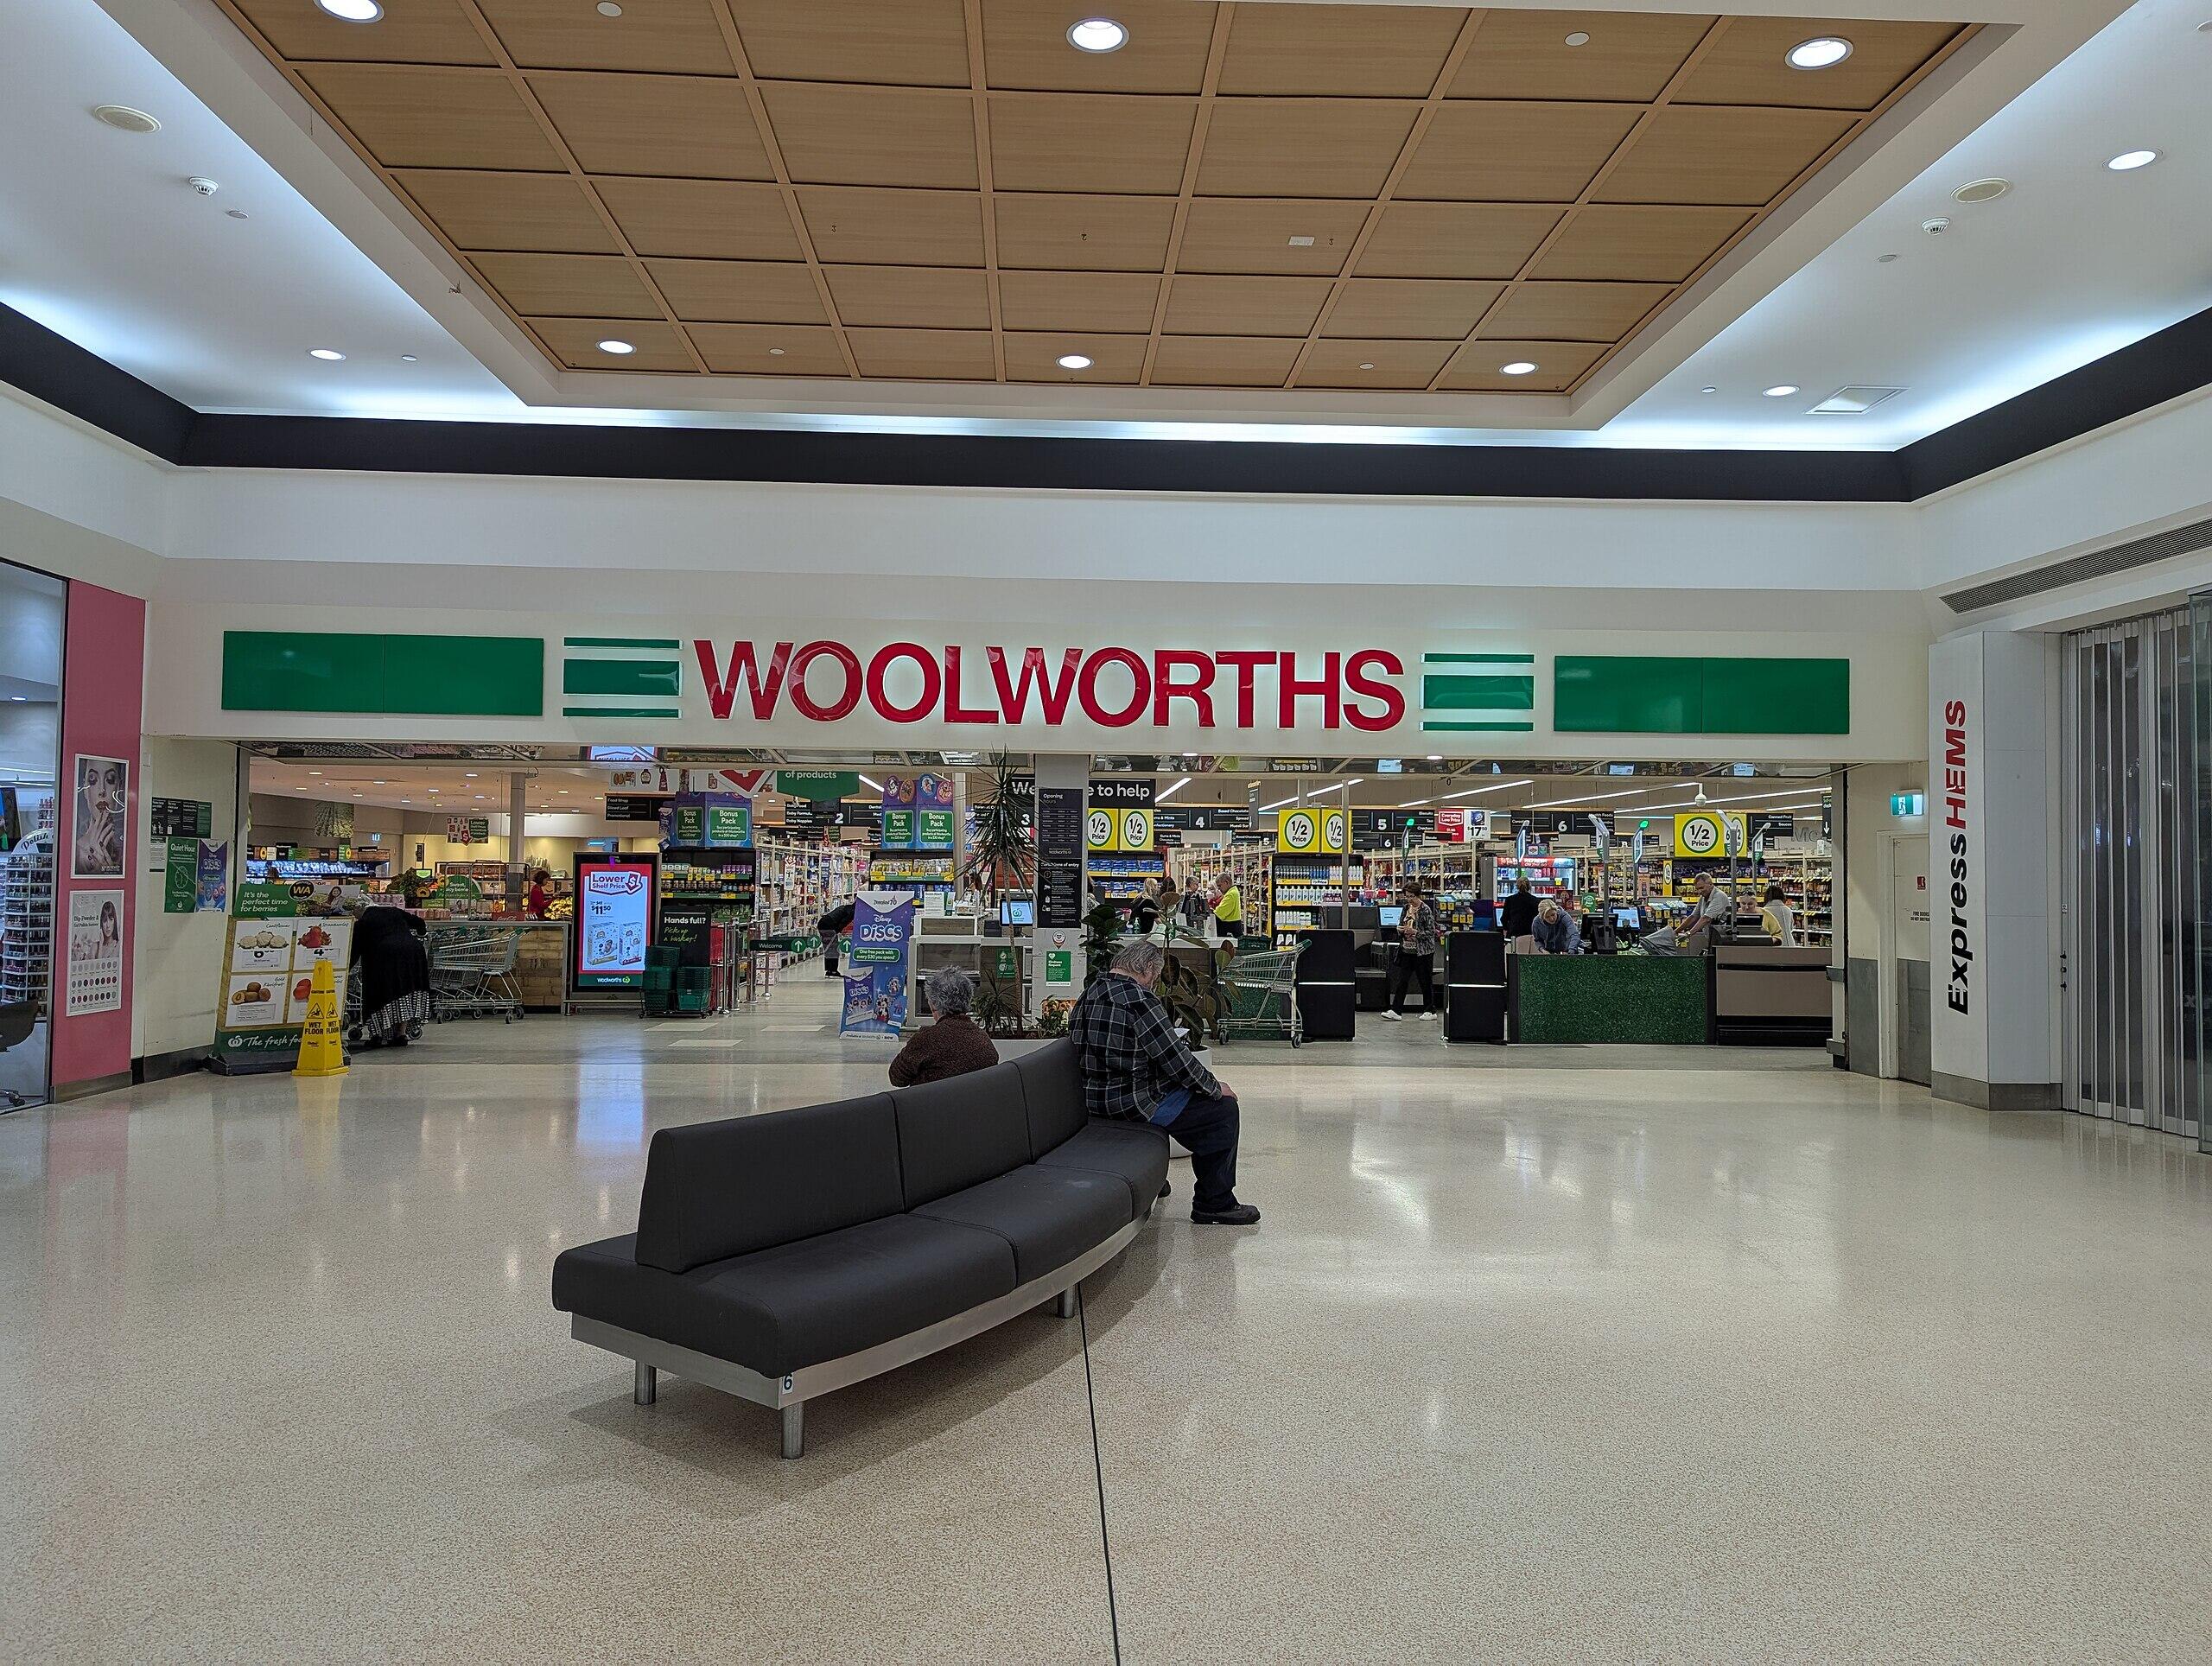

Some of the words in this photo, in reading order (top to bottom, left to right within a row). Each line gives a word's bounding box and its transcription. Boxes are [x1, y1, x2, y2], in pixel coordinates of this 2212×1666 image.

[693, 639, 1406, 733] WOOLWORTHS
[1944, 698, 1967, 830] HEMS
[796, 771, 837, 780] products
[1097, 785, 1114, 797] to
[1116, 783, 1150, 800] help
[835, 813, 844, 824] 2
[1020, 813, 1031, 825] 3
[1195, 816, 1205, 829] 4
[1377, 818, 1387, 830] 5
[1091, 817, 1106, 834] 1/2
[1129, 818, 1143, 835] 1/2
[1291, 820, 1308, 836] 1/2
[1558, 820, 1567, 831] 6
[1689, 824, 1710, 840] 1/2
[21, 831, 49, 851] Polish
[1384, 839, 1391, 848] 6
[1757, 841, 1761, 849] 11
[170, 843, 184, 853] Quiet
[184, 844, 196, 853] Hour
[592, 874, 626, 883] Lower
[293, 885, 311, 894] WA
[873, 913, 892, 924] Disney
[1947, 832, 1974, 1015] Express
[670, 934, 697, 944] basket!
[244, 1036, 264, 1048] The
[264, 1034, 288, 1049] fresh
[783, 1373, 793, 1390] 6
